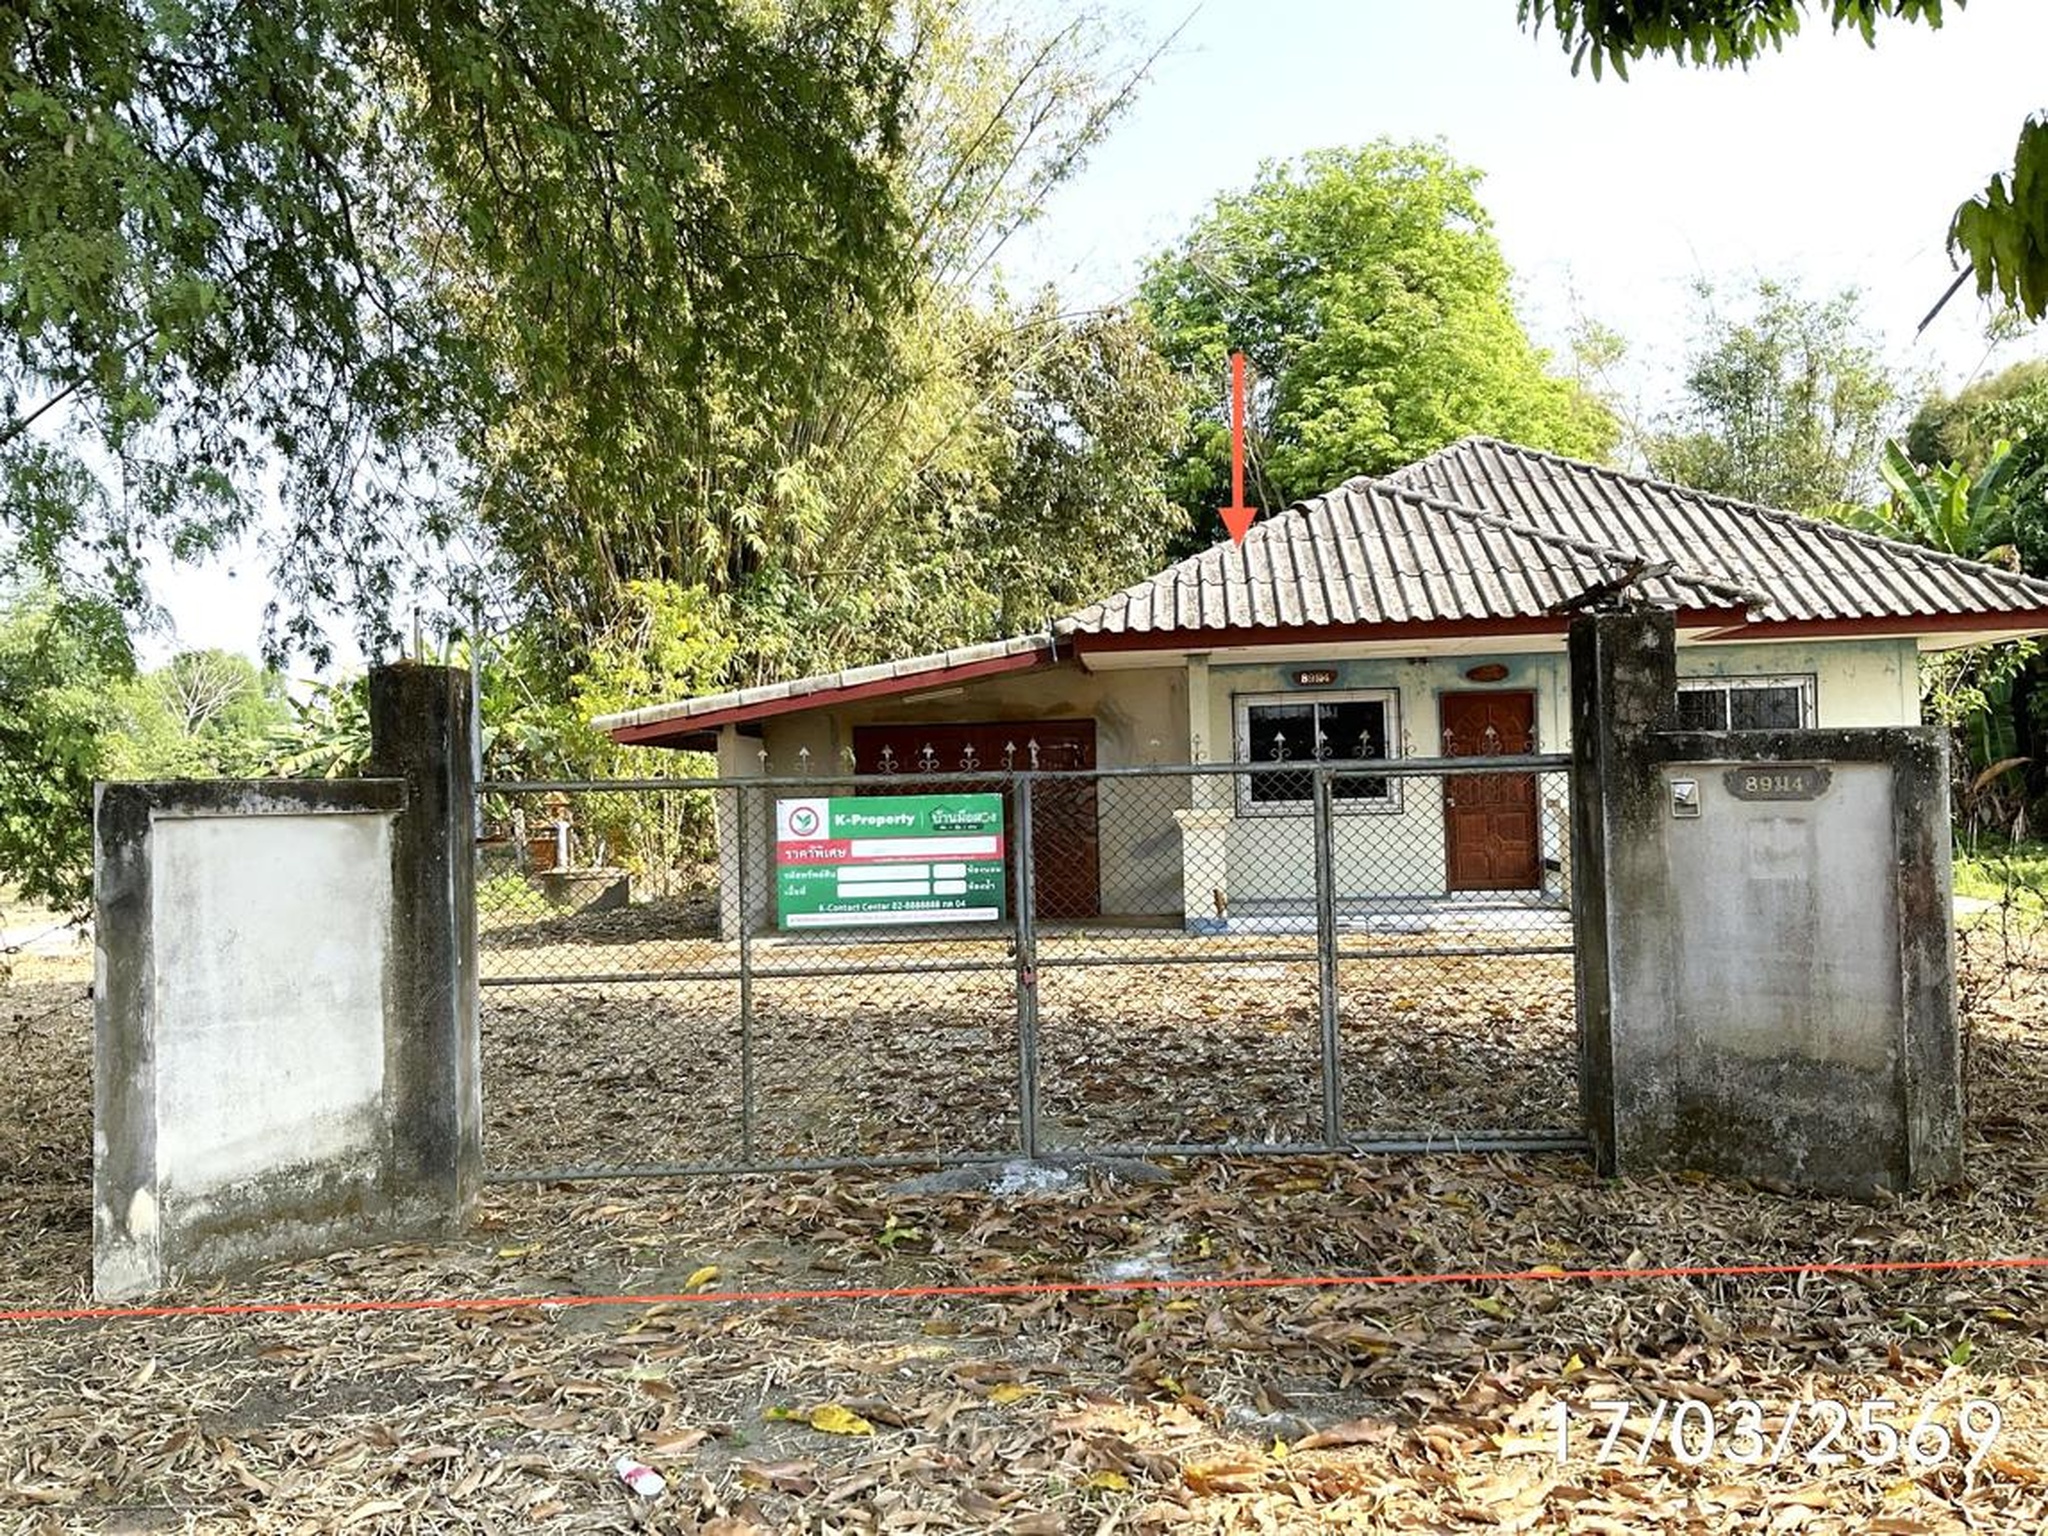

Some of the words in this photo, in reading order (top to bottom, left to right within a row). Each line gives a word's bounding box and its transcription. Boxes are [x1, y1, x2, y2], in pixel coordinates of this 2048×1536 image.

[834, 812, 915, 827] K-Property
[931, 808, 997, 824] บ้านมือสอง
[784, 845, 847, 859] ราคาพิเศษ
[818, 903, 860, 913] K-Contact
[862, 902, 890, 912] Center
[891, 901, 940, 911] 02-8888888
[955, 899, 966, 908] 04
